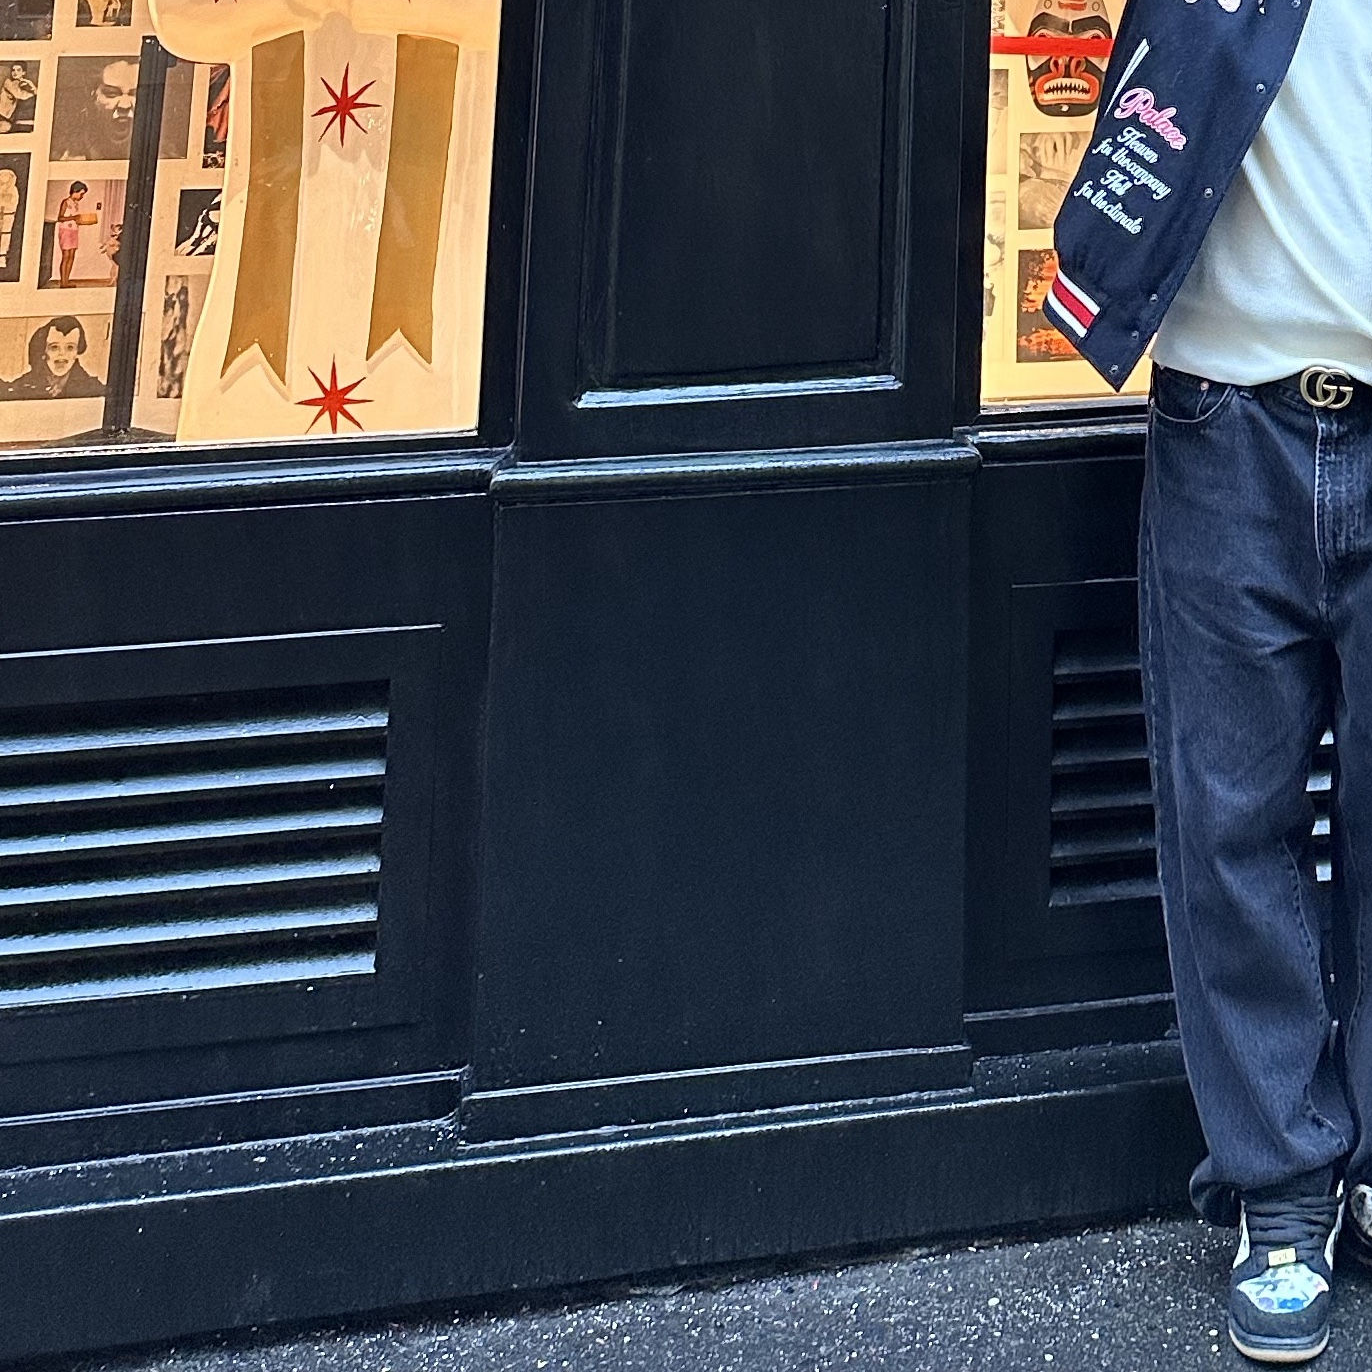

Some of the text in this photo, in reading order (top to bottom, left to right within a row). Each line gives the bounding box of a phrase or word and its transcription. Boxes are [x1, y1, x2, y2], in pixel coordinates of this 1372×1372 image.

[1113, 86, 1188, 151] Palace
[1092, 137, 1114, 157] for
[1117, 126, 1160, 164] Heaven
[1073, 180, 1094, 199] for
[1100, 169, 1134, 197] Hell
